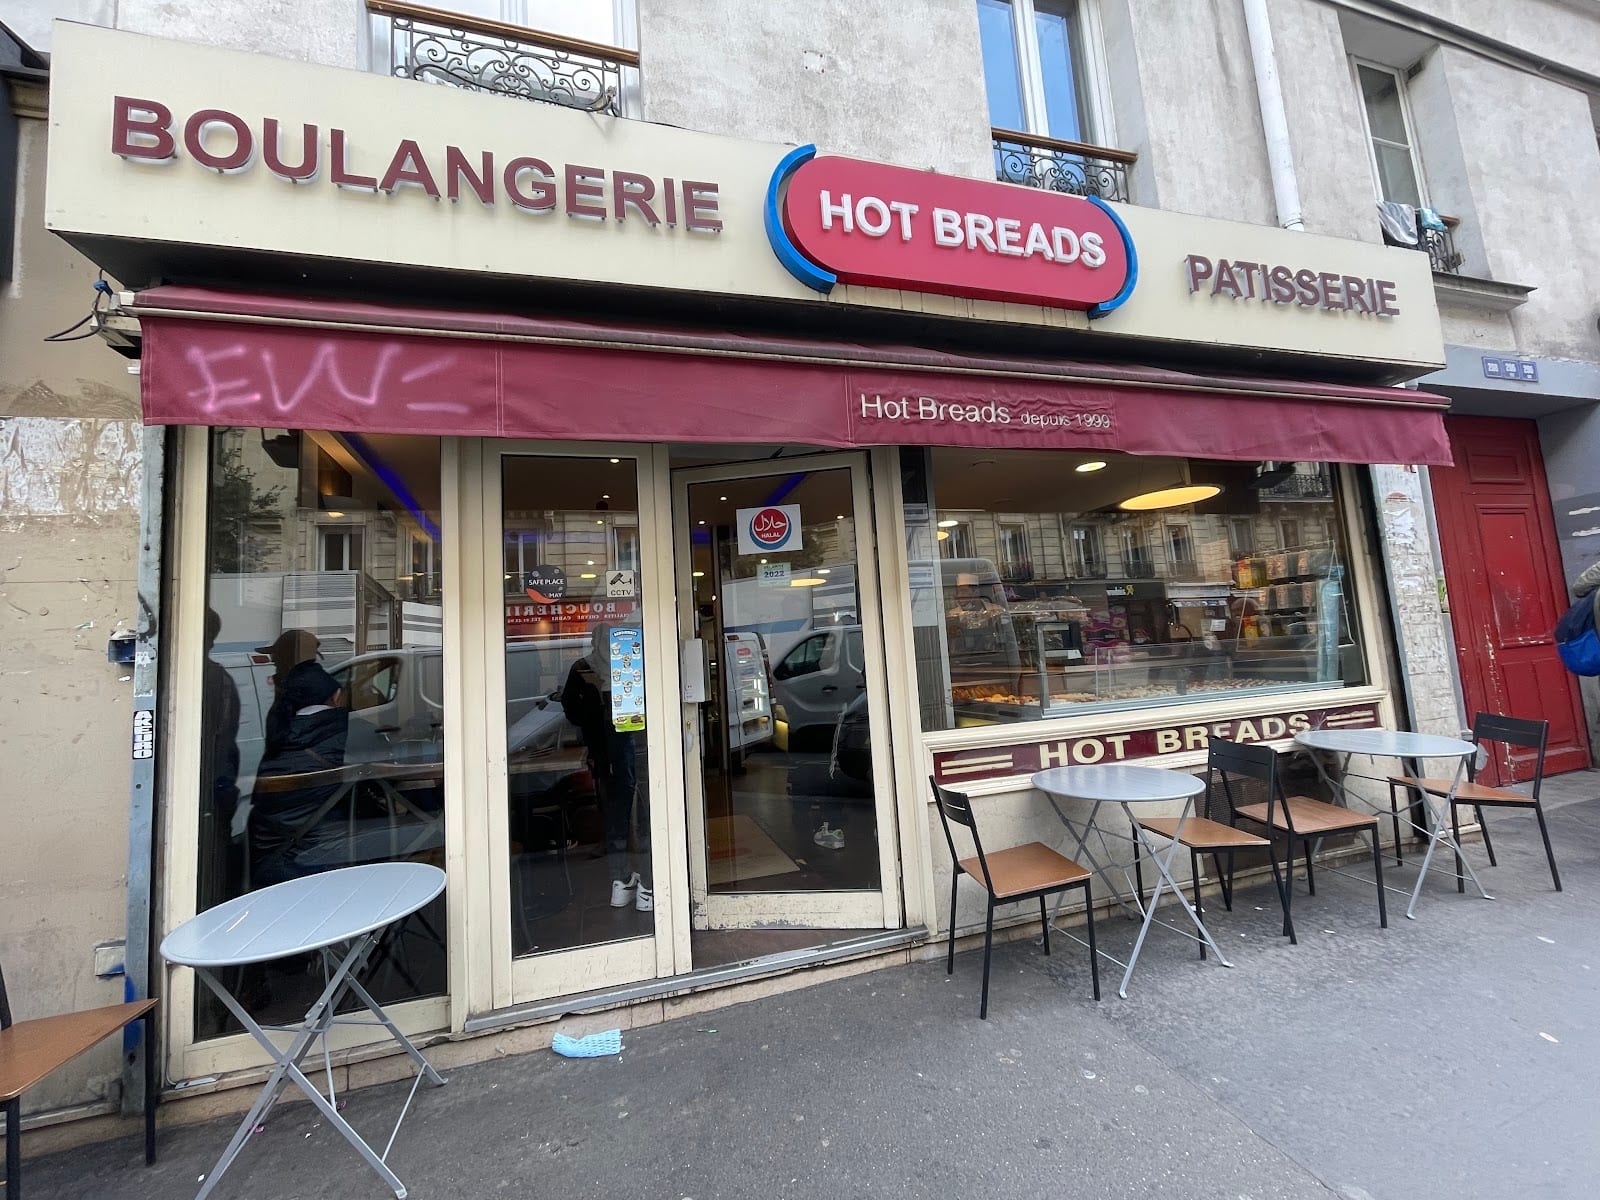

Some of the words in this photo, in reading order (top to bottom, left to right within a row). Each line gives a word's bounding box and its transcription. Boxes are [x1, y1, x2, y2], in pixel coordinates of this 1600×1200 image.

[111, 95, 724, 232] BOULANGERIE
[819, 189, 919, 241] HOT
[932, 207, 1107, 269] BREADS
[1185, 254, 1400, 317] PATISSERIE
[860, 394, 916, 421] Hot
[918, 397, 1010, 425] Breads
[1020, 410, 1071, 429] depuis
[1074, 412, 1111, 429] 1999
[755, 514, 786, 532] حلال
[764, 570, 785, 578] 2022
[1039, 735, 1131, 769] HOT
[1156, 713, 1311, 754] BREADS
